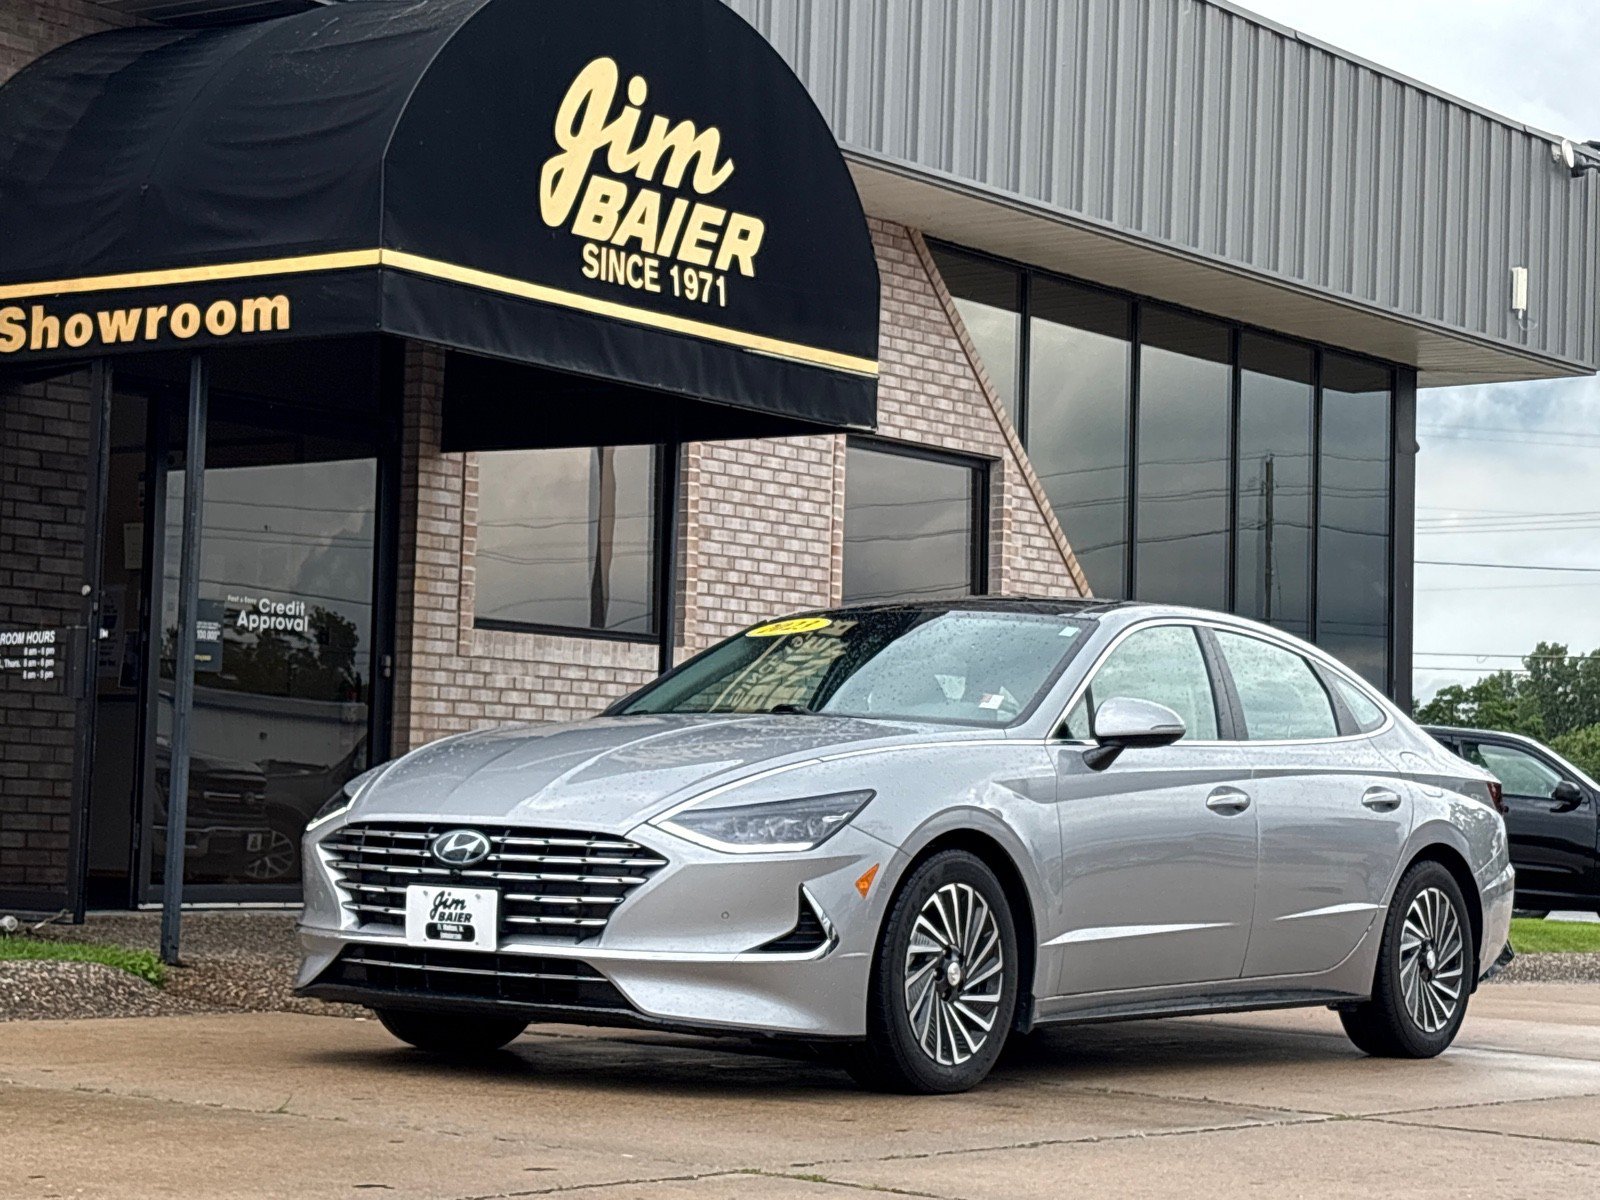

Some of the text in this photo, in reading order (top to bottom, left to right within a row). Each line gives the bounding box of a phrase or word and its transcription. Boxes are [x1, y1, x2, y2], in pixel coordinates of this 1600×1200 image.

[539, 56, 734, 228] Jim
[571, 175, 765, 278] BAIER
[581, 243, 727, 308] SINCE 1971
[0, 294, 291, 353] Showroom
[258, 598, 306, 616] Credit
[237, 610, 309, 632] Approval
[26, 630, 55, 644] HOURS
[45, 647, 55, 657] pm
[45, 659, 55, 669] pm
[44, 671, 54, 682] pm
[430, 890, 466, 920] Jim
[438, 912, 472, 922] BAIER
